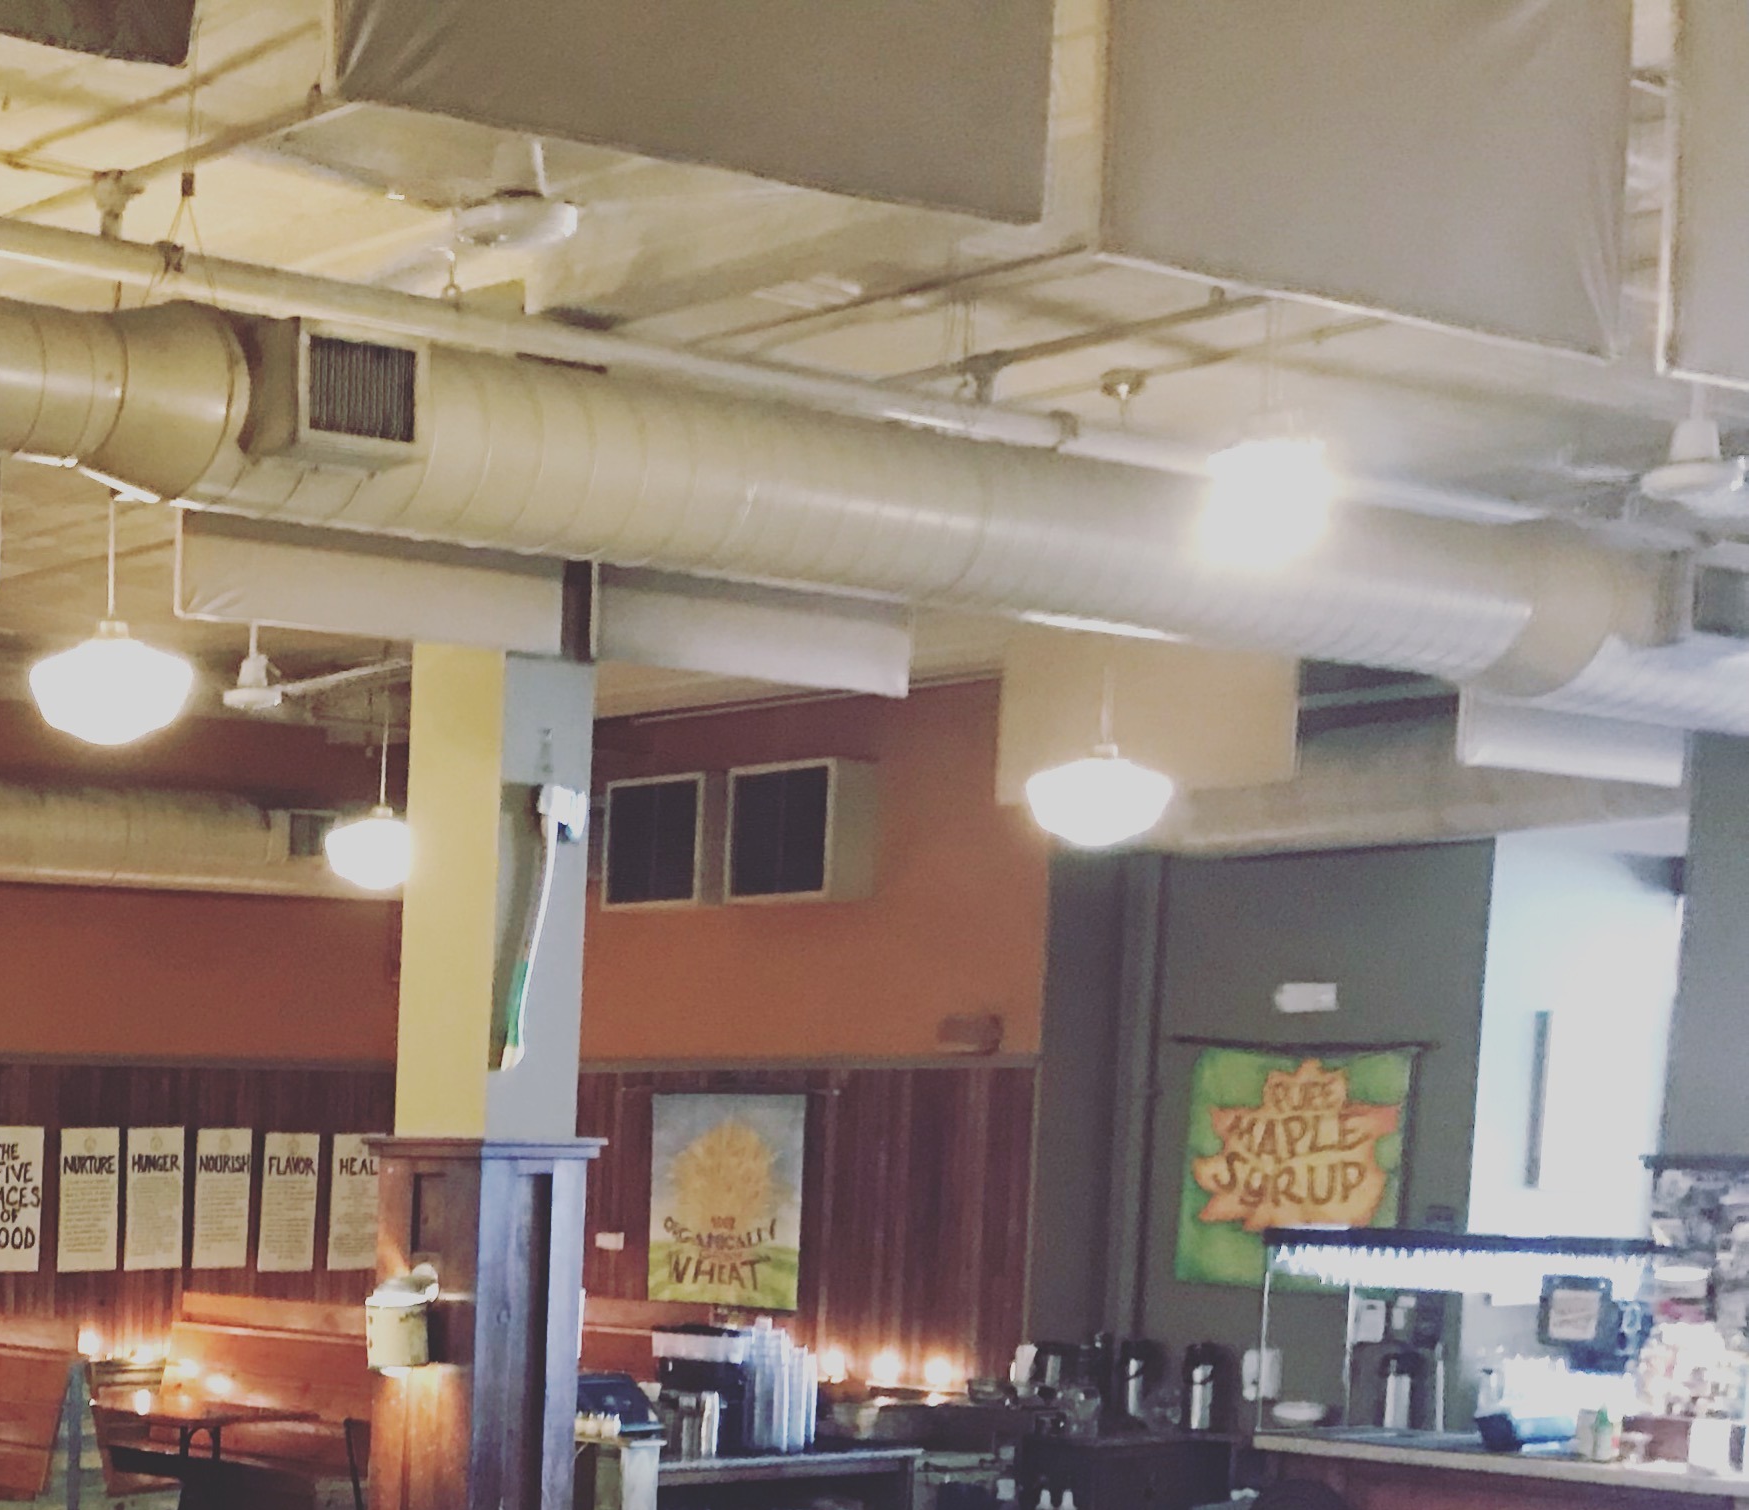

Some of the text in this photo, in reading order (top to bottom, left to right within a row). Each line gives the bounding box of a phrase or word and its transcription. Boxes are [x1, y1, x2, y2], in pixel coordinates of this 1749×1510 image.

[1270, 1079, 1339, 1113] PURE
[1226, 1112, 1373, 1165] MAPLE
[63, 1154, 116, 1175] NURTURE
[131, 1153, 181, 1174] HUNGER
[198, 1154, 251, 1175] NOURISH
[268, 1155, 317, 1177] FLAVOR
[0, 1208, 21, 1224] OF
[668, 1250, 771, 1291] WHEAT
